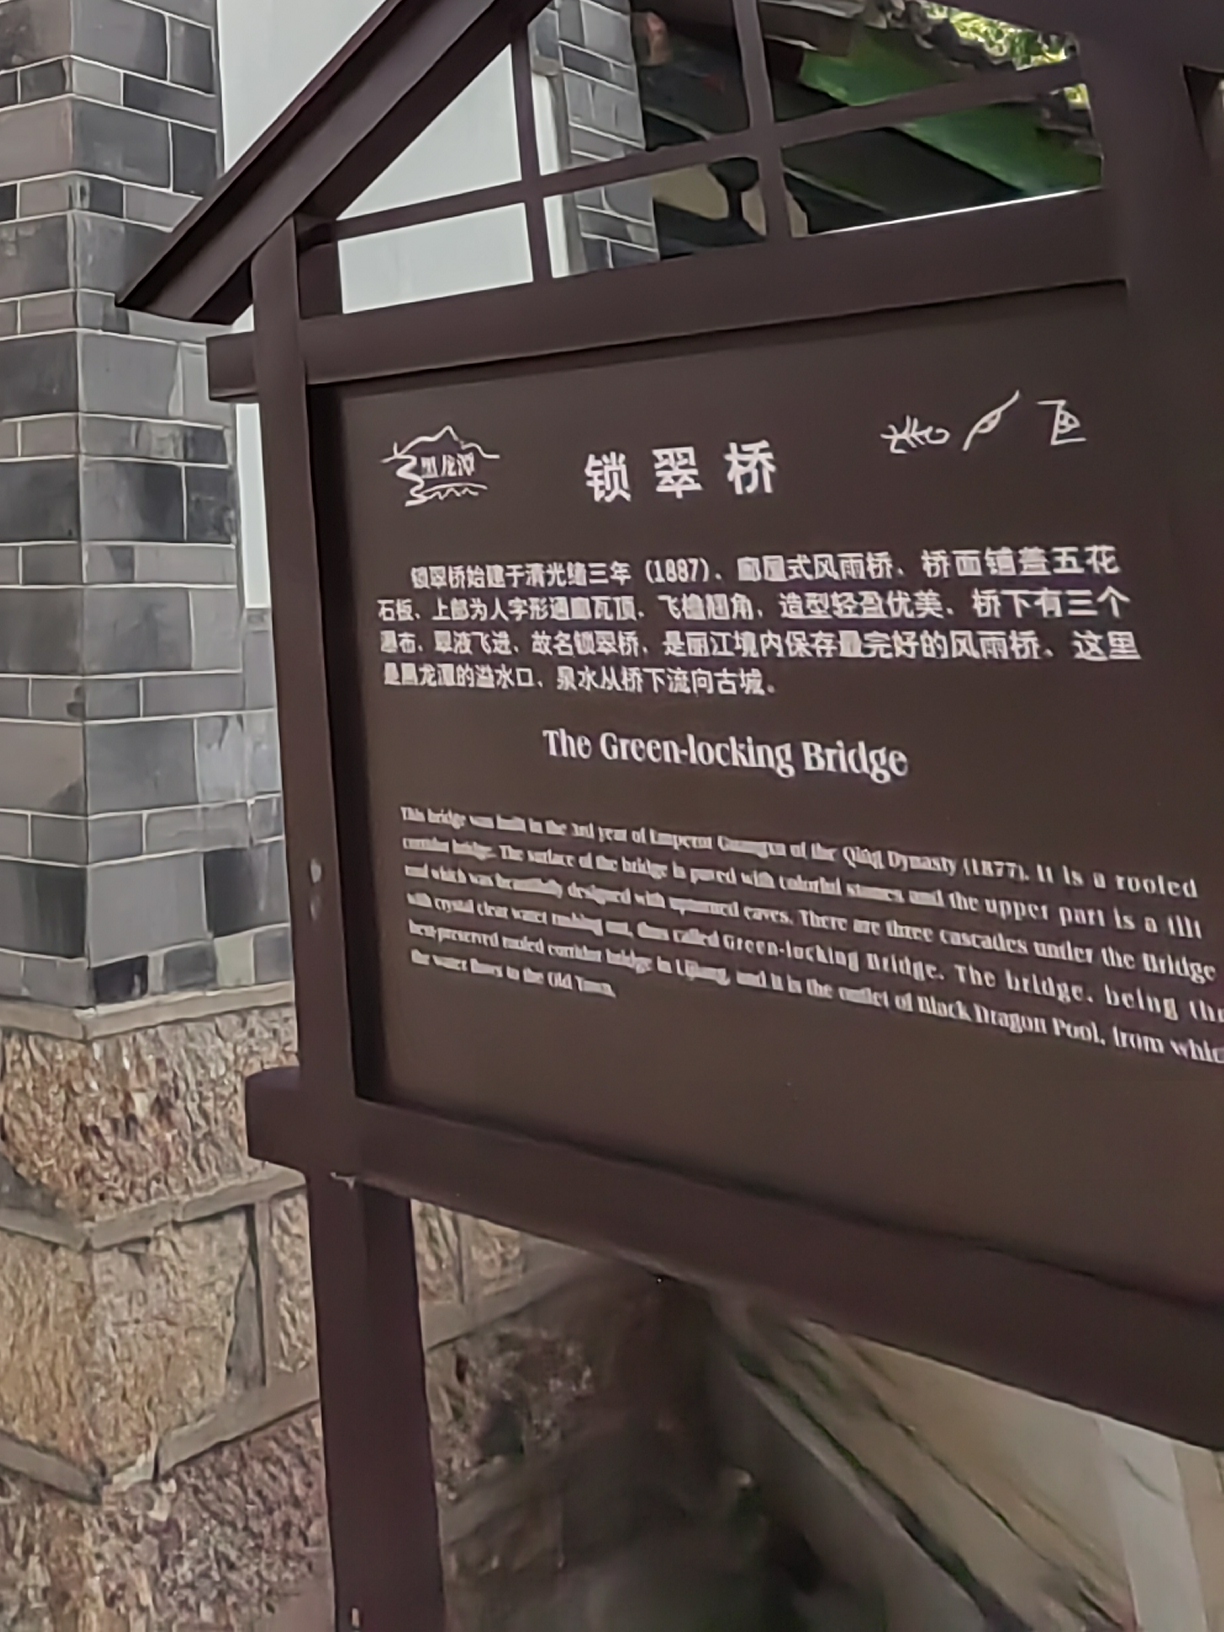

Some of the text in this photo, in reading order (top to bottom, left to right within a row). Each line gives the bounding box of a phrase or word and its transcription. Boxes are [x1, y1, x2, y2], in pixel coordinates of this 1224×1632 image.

[584, 439, 777, 503] 锁翠桥
[542, 729, 908, 783] The Green-locking Bridge
[499, 844, 524, 862] The
[621, 856, 668, 880] bridge
[741, 870, 776, 889] with
[948, 891, 979, 912] the
[984, 898, 1049, 921] upper
[1058, 905, 1106, 927] part
[1113, 906, 1136, 930] is
[1144, 917, 1158, 933] a
[632, 827, 646, 844] of
[790, 842, 807, 860] of
[811, 842, 837, 861] the
[842, 846, 885, 870] Qing
[887, 850, 956, 877] Dynasty
[1037, 863, 1054, 884] It
[1062, 864, 1084, 887] is
[1093, 871, 1106, 889] a
[547, 972, 573, 990] Old
[723, 934, 859, 972] Green-locking
[954, 963, 996, 989] The
[1105, 984, 1178, 1020] being
[798, 909, 848, 932] There
[853, 919, 880, 936] are
[885, 920, 934, 943] three
[939, 929, 1029, 955] cascades
[1033, 940, 1093, 964] under
[1101, 945, 1136, 969] the
[1142, 952, 1217, 985] Bridge
[806, 978, 833, 999] the
[895, 992, 913, 1012] of
[917, 995, 971, 1022] Black
[973, 1003, 1047, 1034] Dragon
[1112, 1025, 1165, 1054] from
